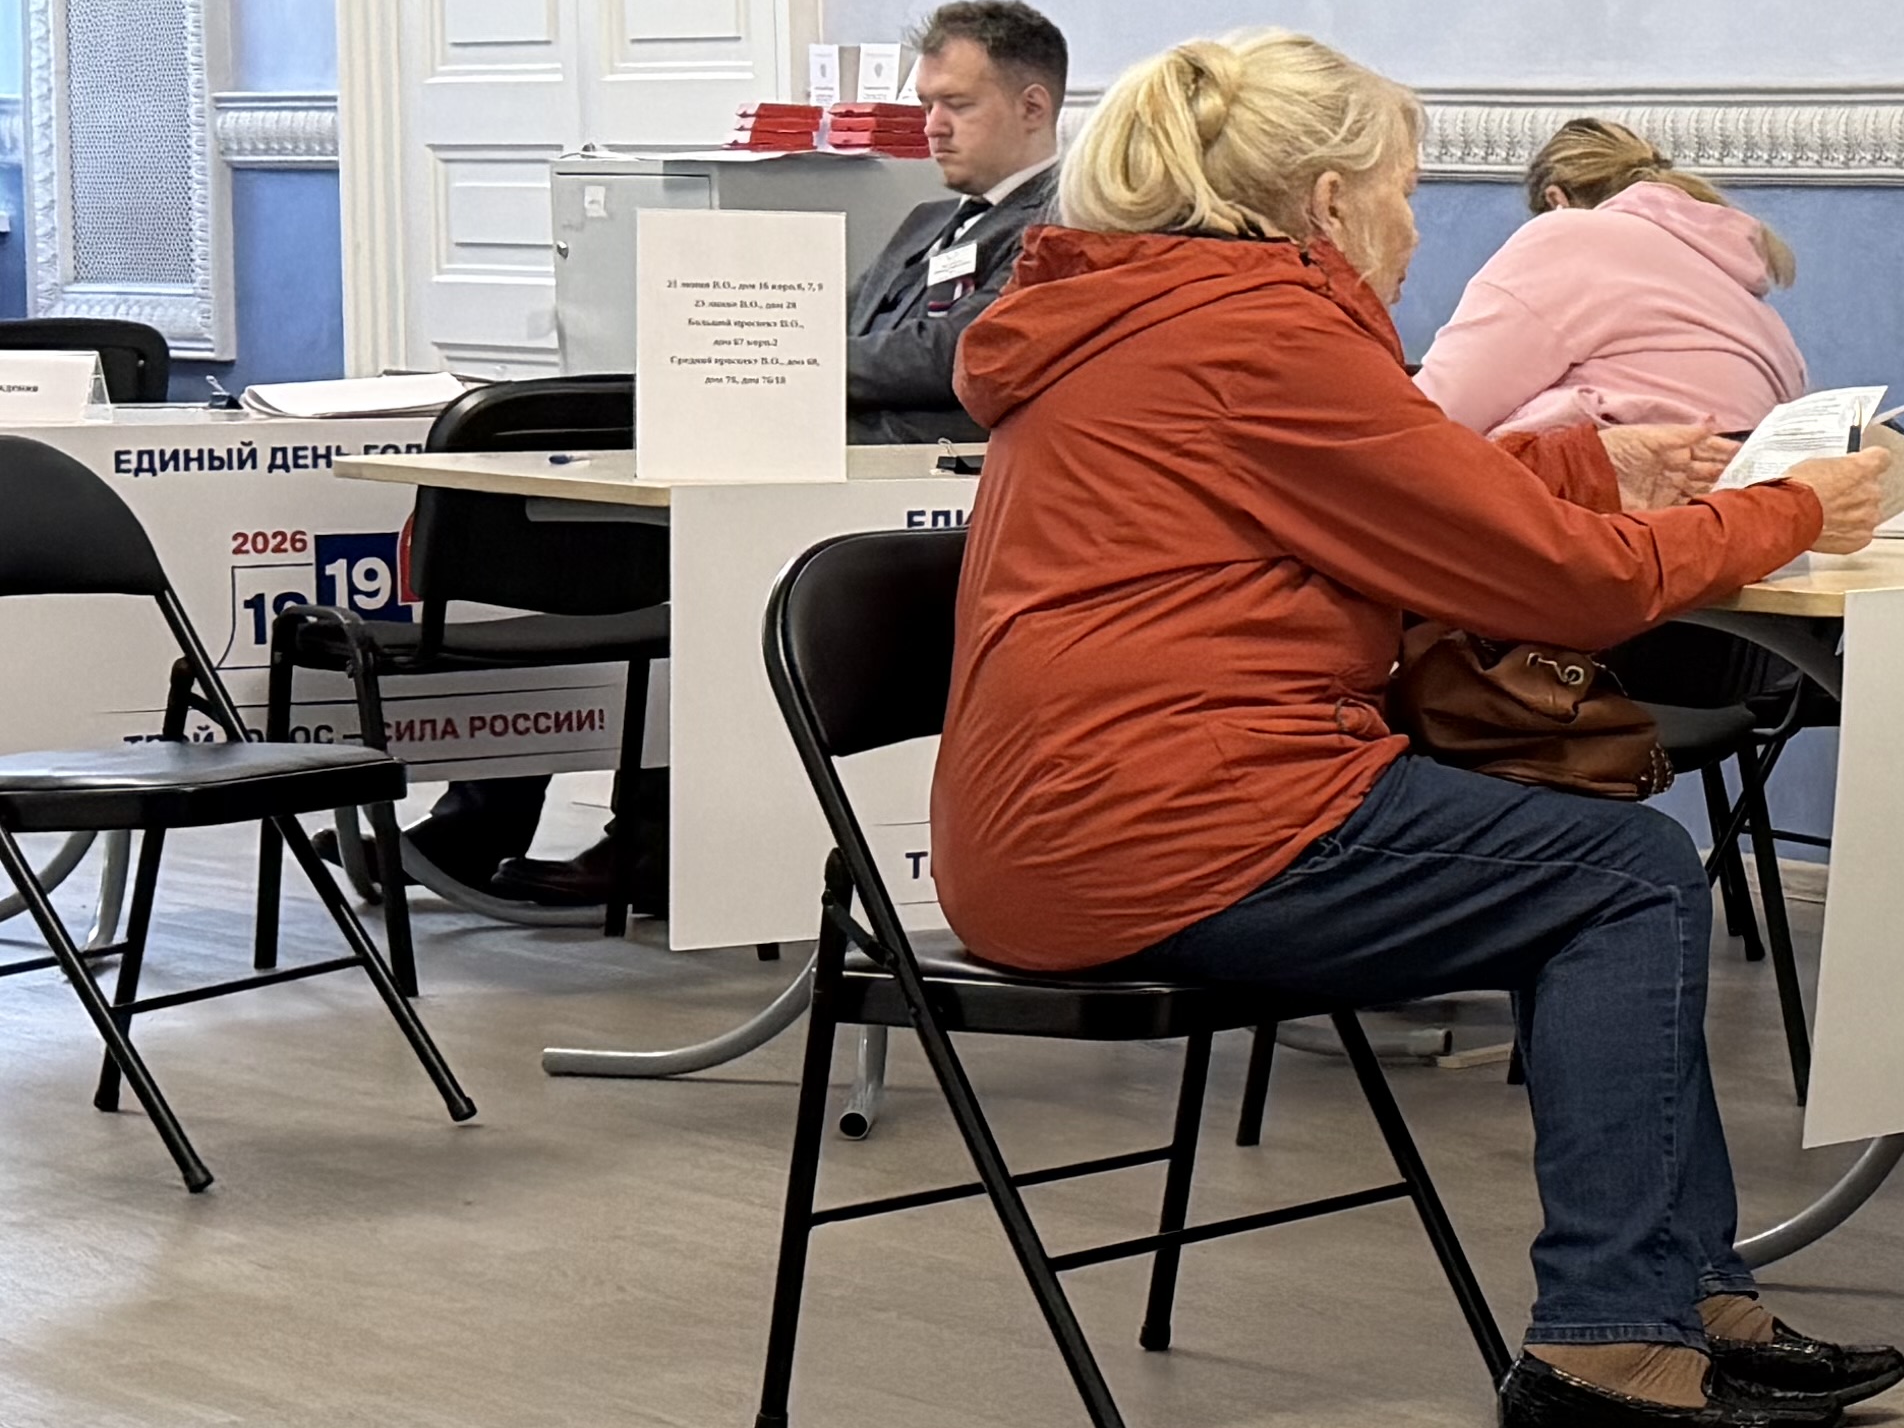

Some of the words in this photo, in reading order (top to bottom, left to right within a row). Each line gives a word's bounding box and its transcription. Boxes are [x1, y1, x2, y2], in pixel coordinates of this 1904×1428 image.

[114, 440, 259, 478] ЕДИНЫЙ
[231, 529, 309, 556] 2026
[325, 557, 393, 611] 19
[469, 708, 605, 739] РОССИИ!
